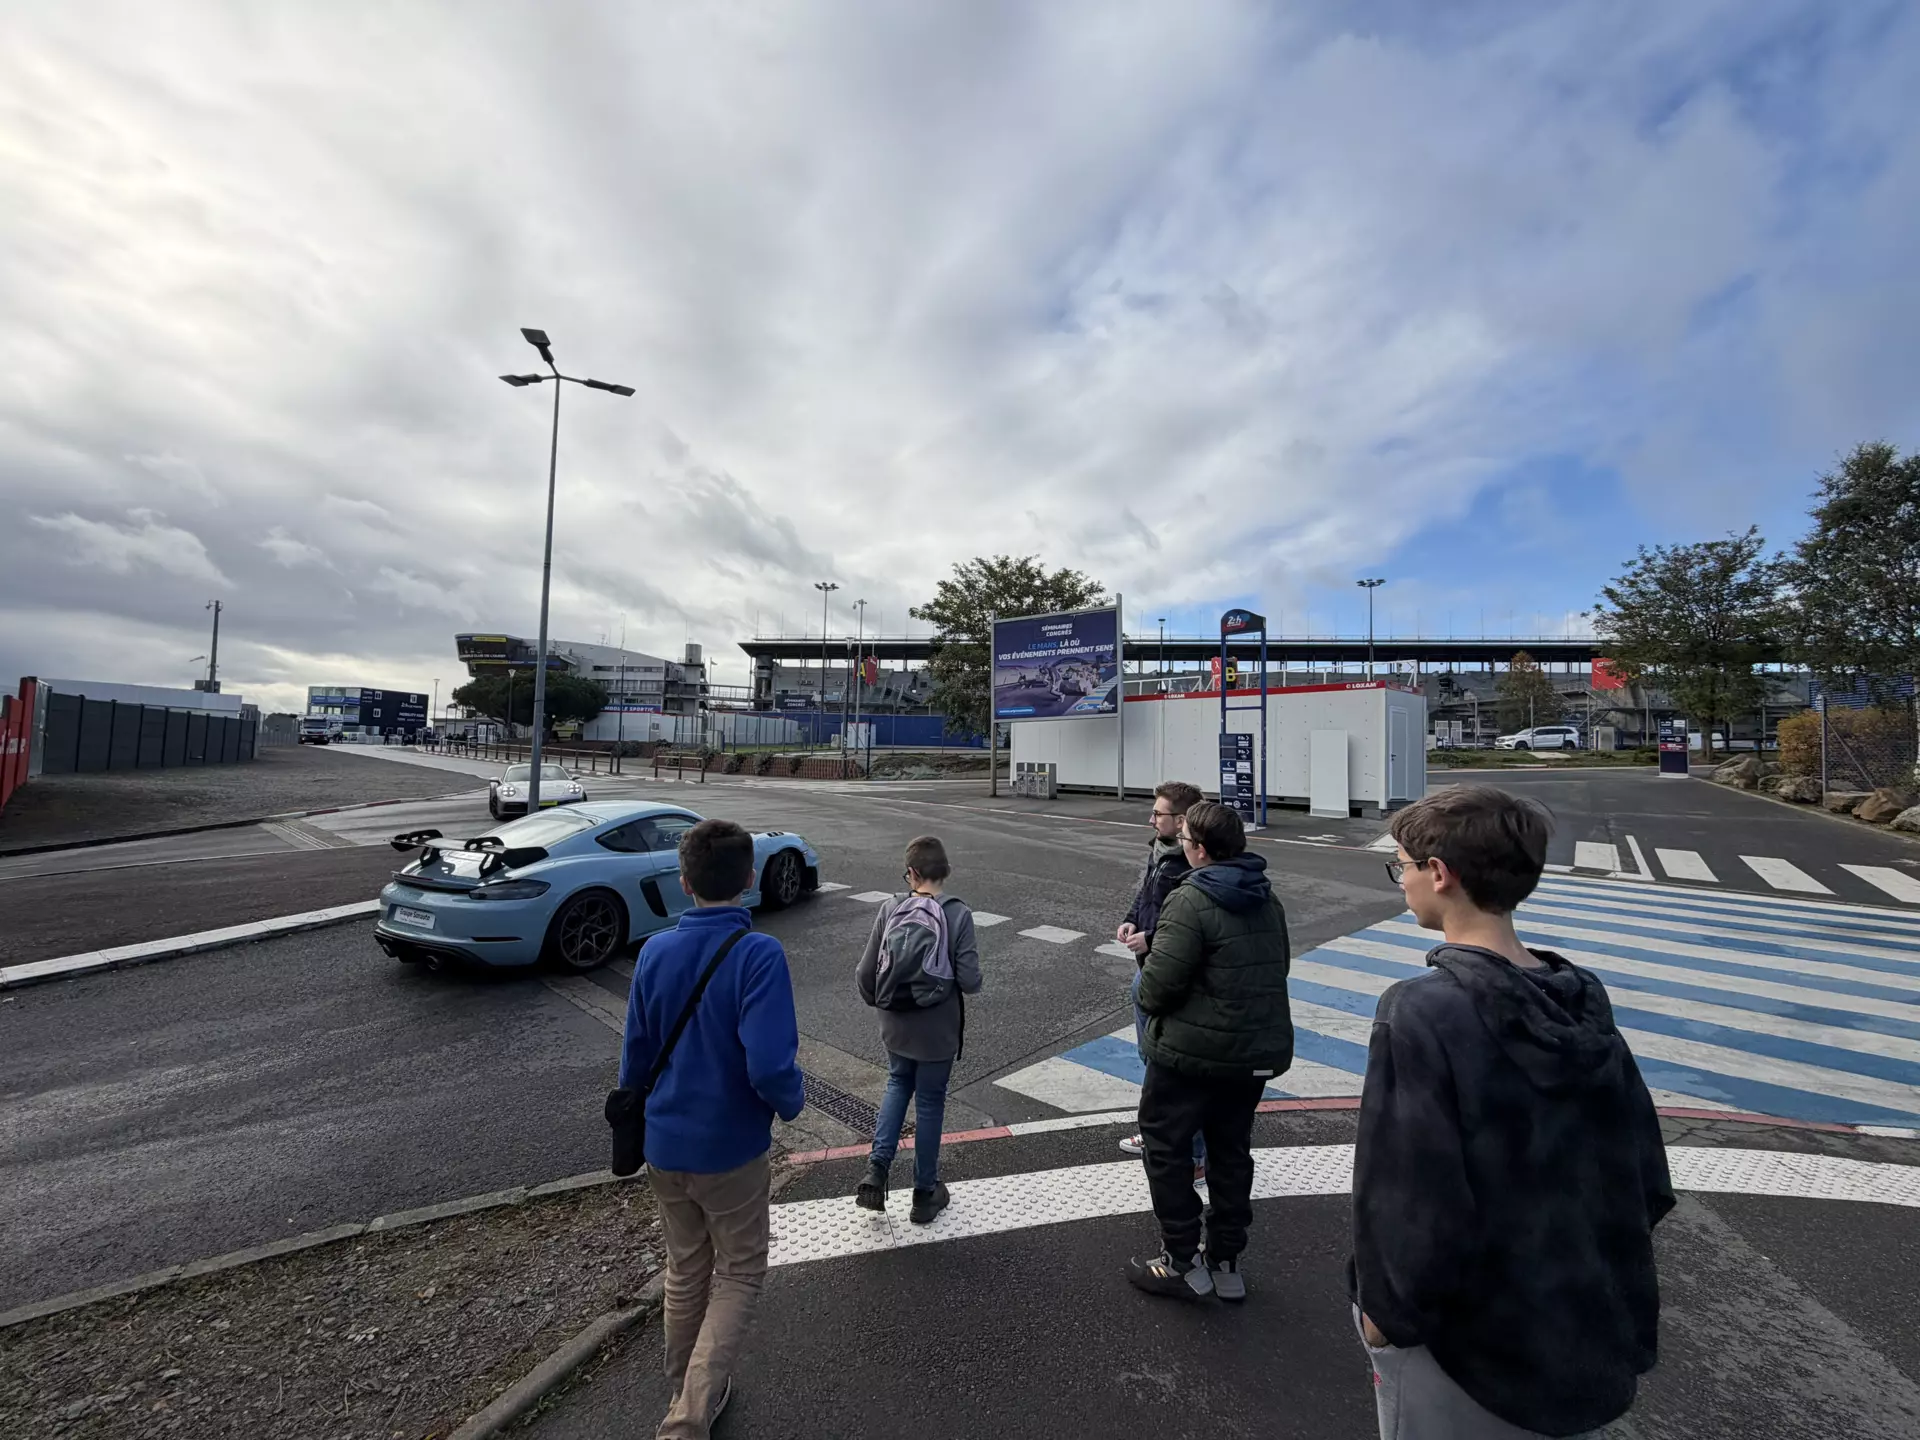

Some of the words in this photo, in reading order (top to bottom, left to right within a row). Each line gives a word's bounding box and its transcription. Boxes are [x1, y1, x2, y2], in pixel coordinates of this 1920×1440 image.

[1041, 623, 1073, 631] SÉMINAIRES
[1046, 629, 1072, 637] CONGRÈS
[1060, 638, 1069, 648] LÀ
[1070, 637, 1080, 647] OÙ
[1012, 649, 1056, 660] ÉVÉNEMENTS
[1056, 645, 1094, 656] PRENNENT
[1095, 643, 1114, 652] SENS
[1226, 666, 1237, 682] B
